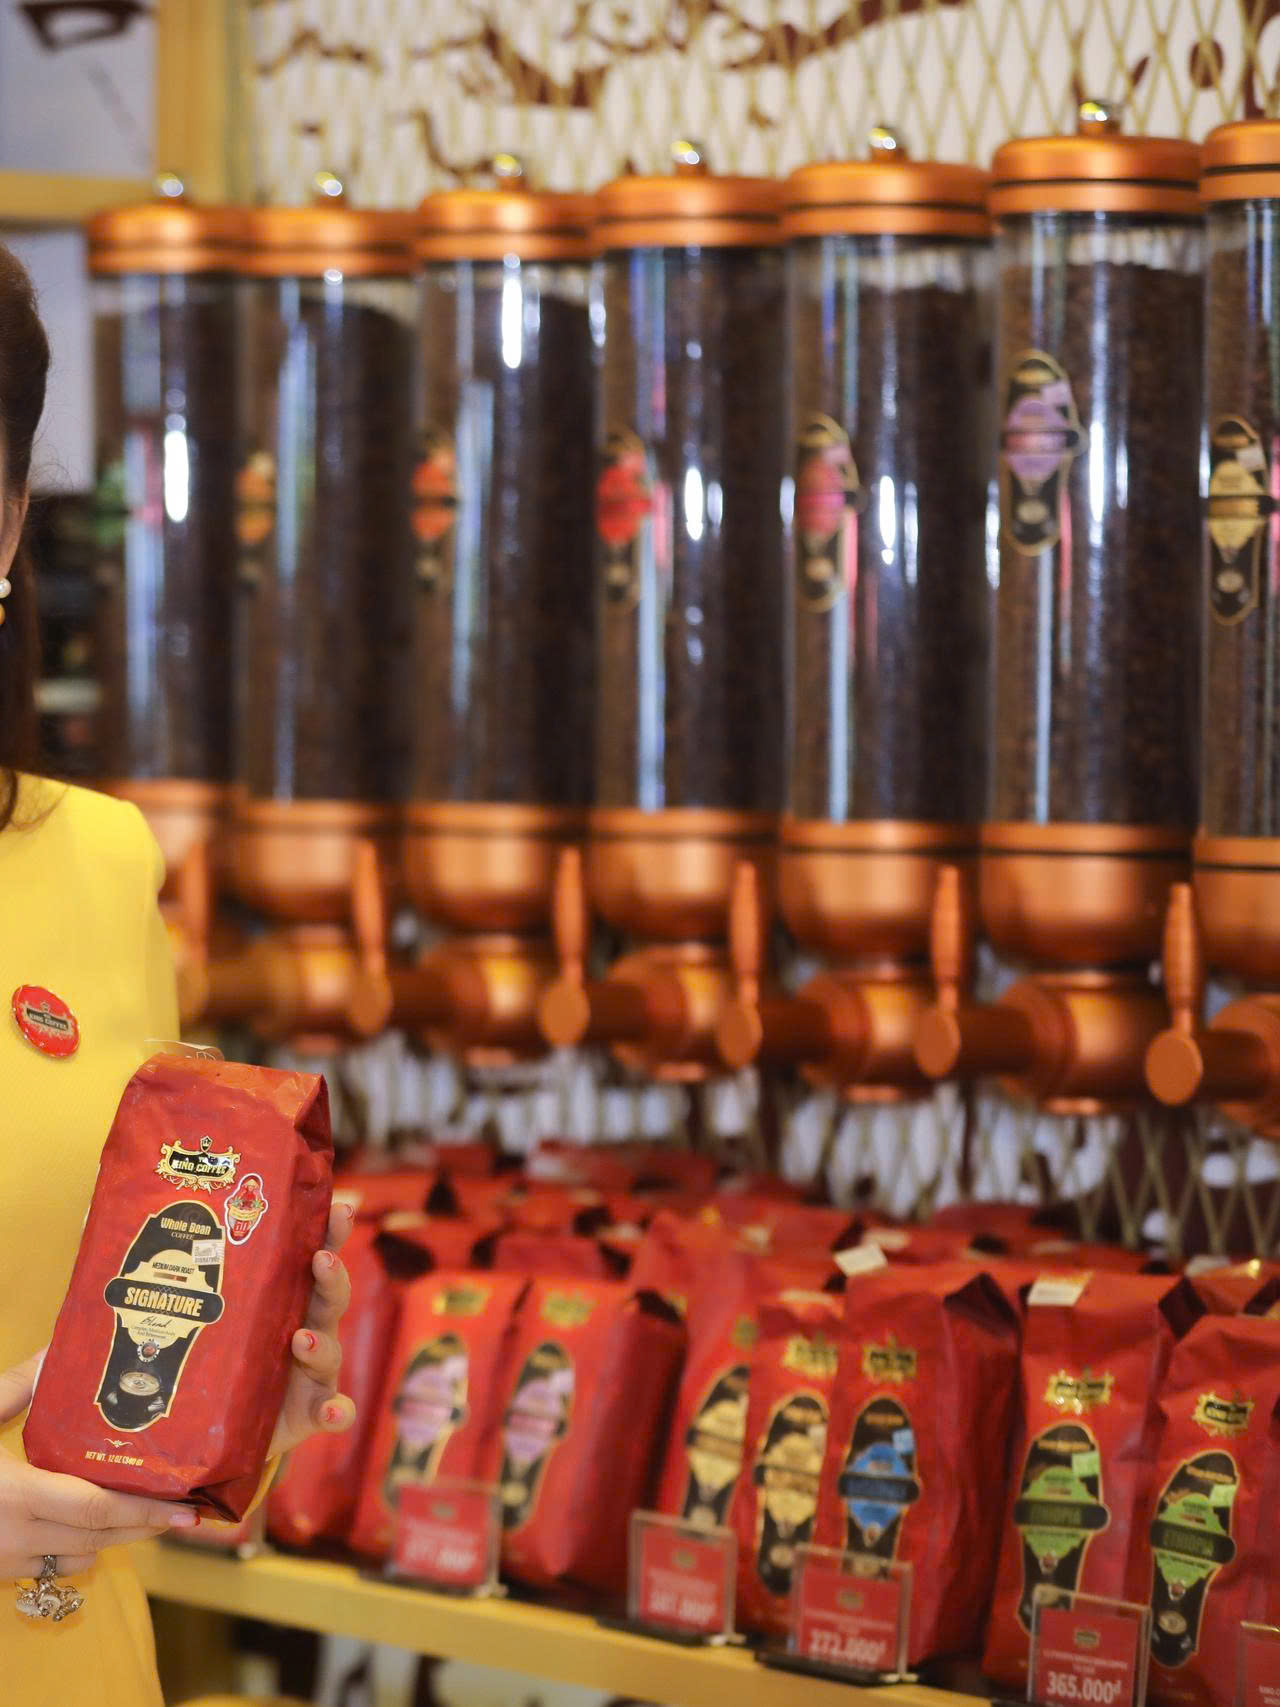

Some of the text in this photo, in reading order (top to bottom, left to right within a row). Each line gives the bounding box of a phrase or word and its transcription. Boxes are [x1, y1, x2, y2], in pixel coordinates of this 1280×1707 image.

[160, 1217, 212, 1235] Whole Bean
[124, 1286, 204, 1317] SIGNATURE
